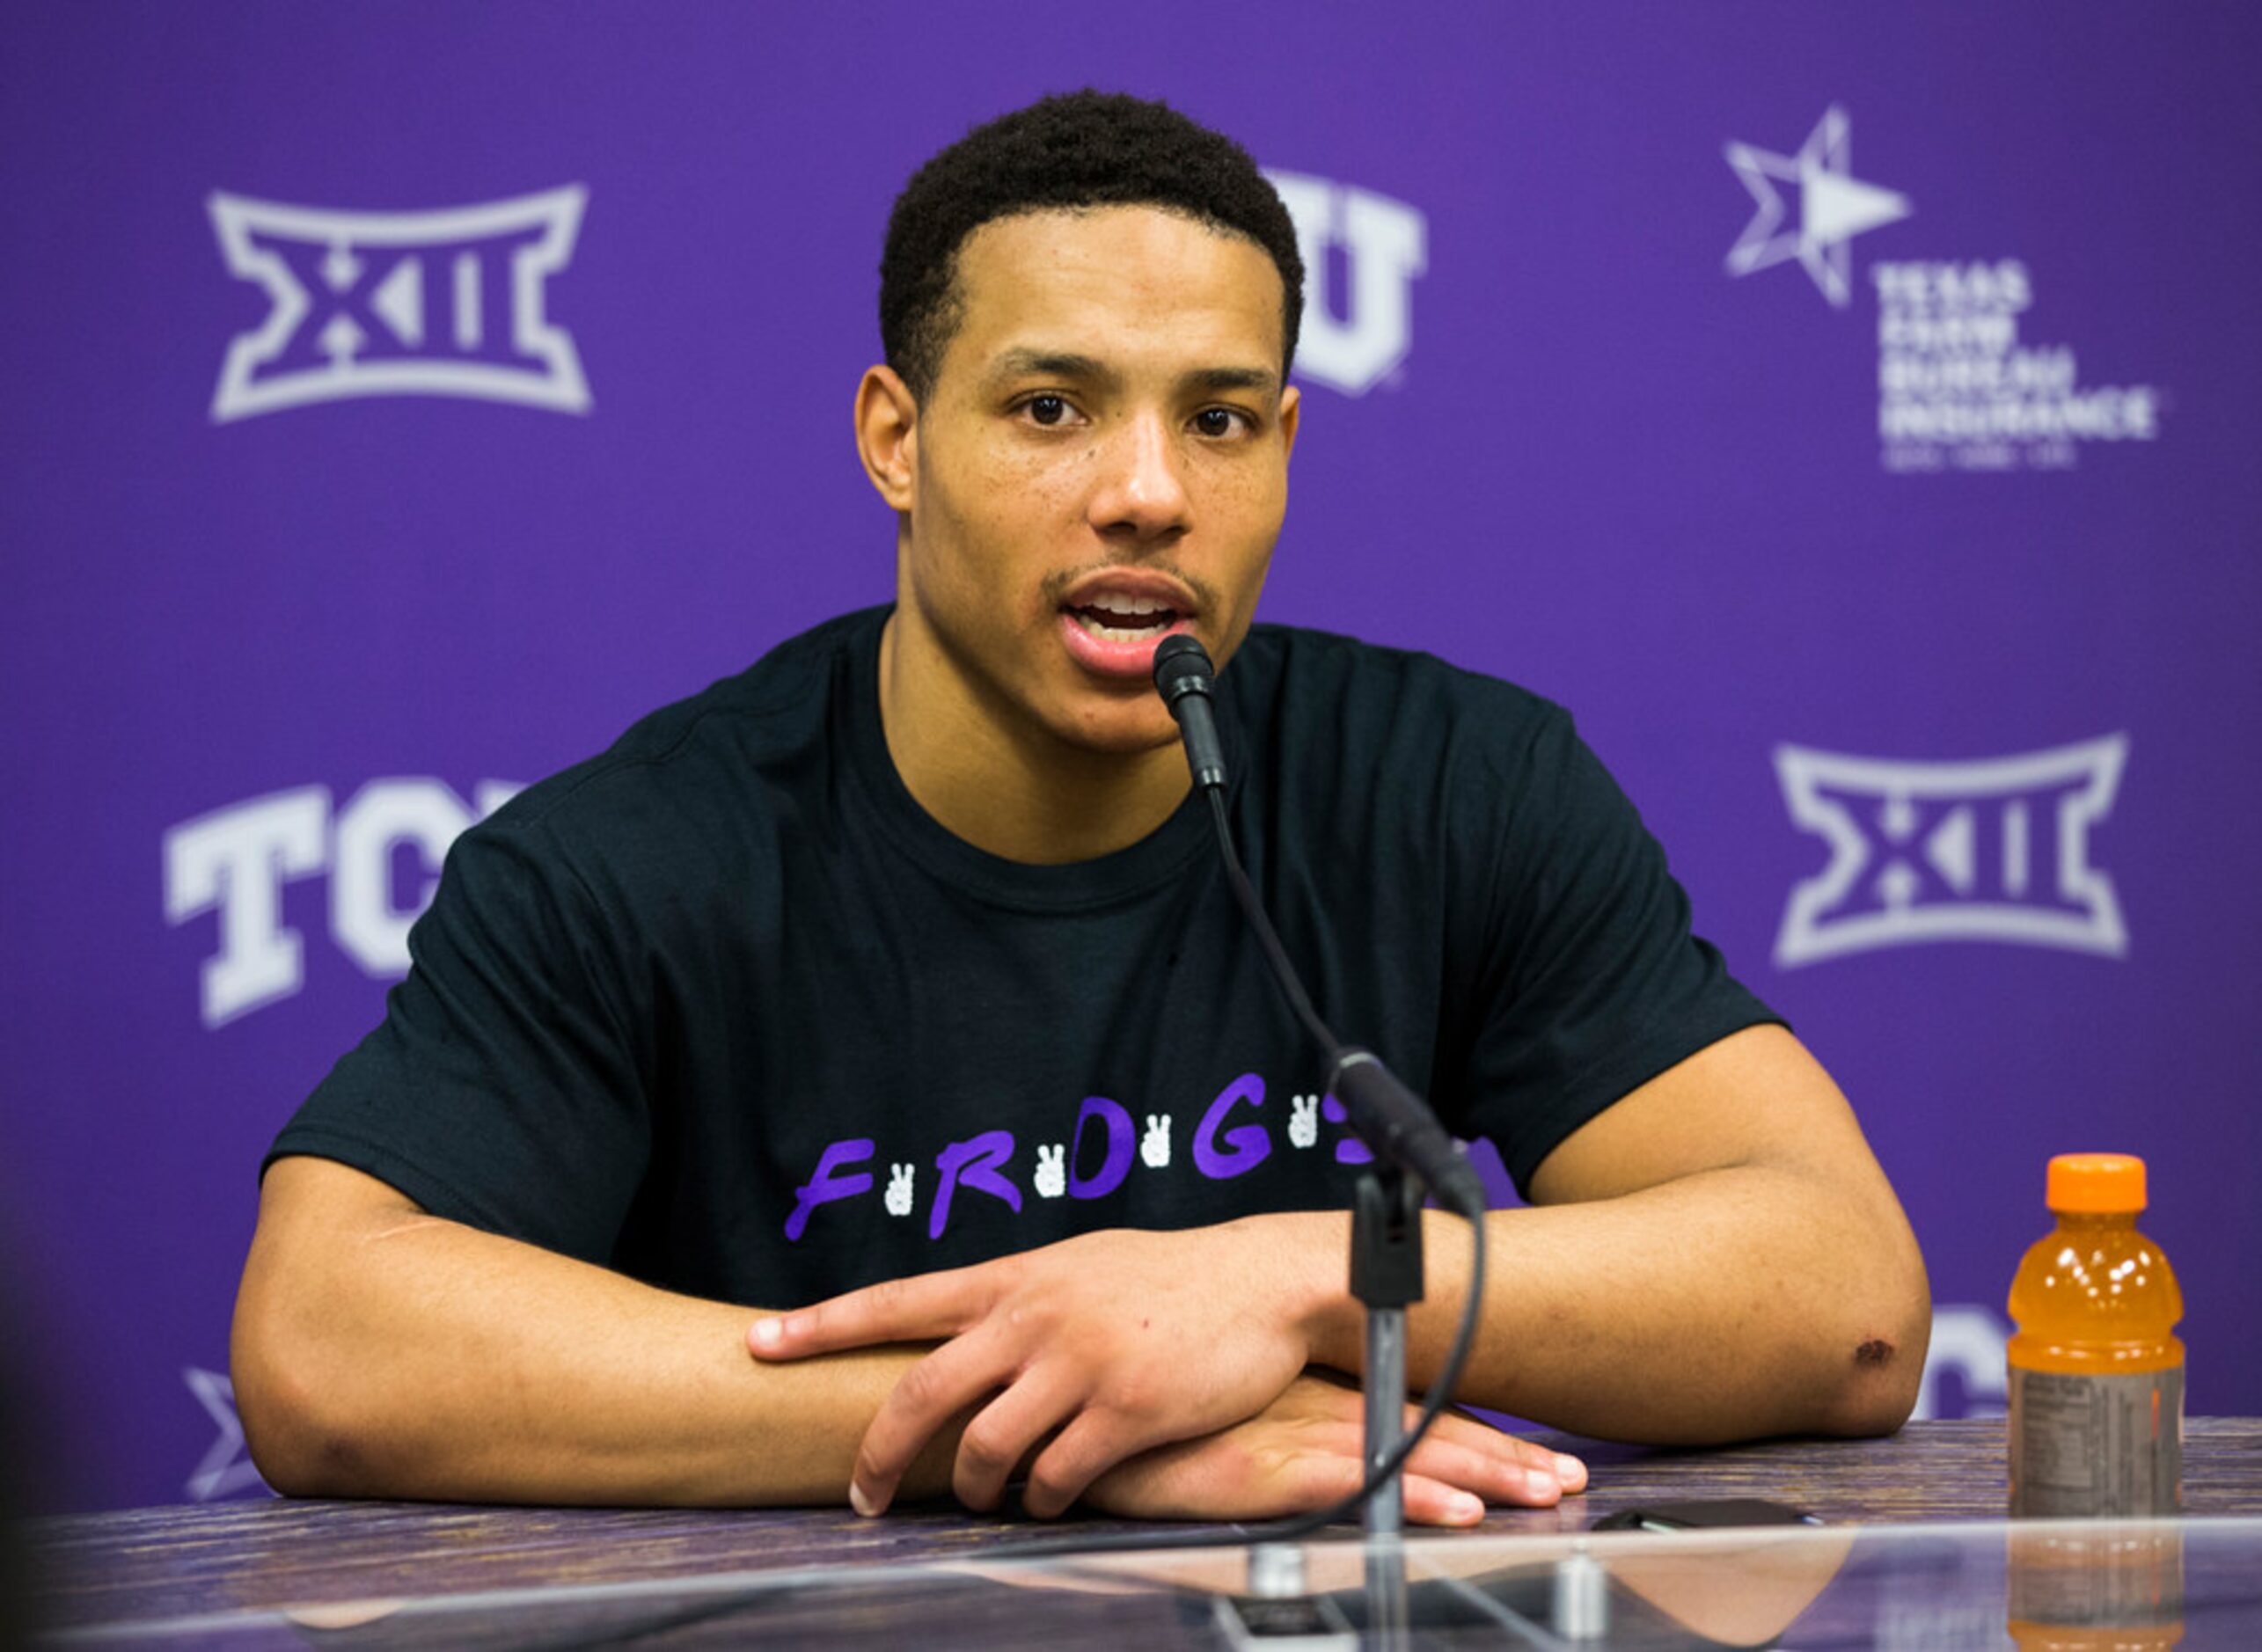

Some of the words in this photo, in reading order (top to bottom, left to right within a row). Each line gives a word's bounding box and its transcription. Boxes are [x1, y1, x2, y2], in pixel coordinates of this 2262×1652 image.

[1874, 260, 2031, 311] TEXAS
[1880, 387, 2156, 442] INSURANCE
[165, 778, 530, 1029] TC
